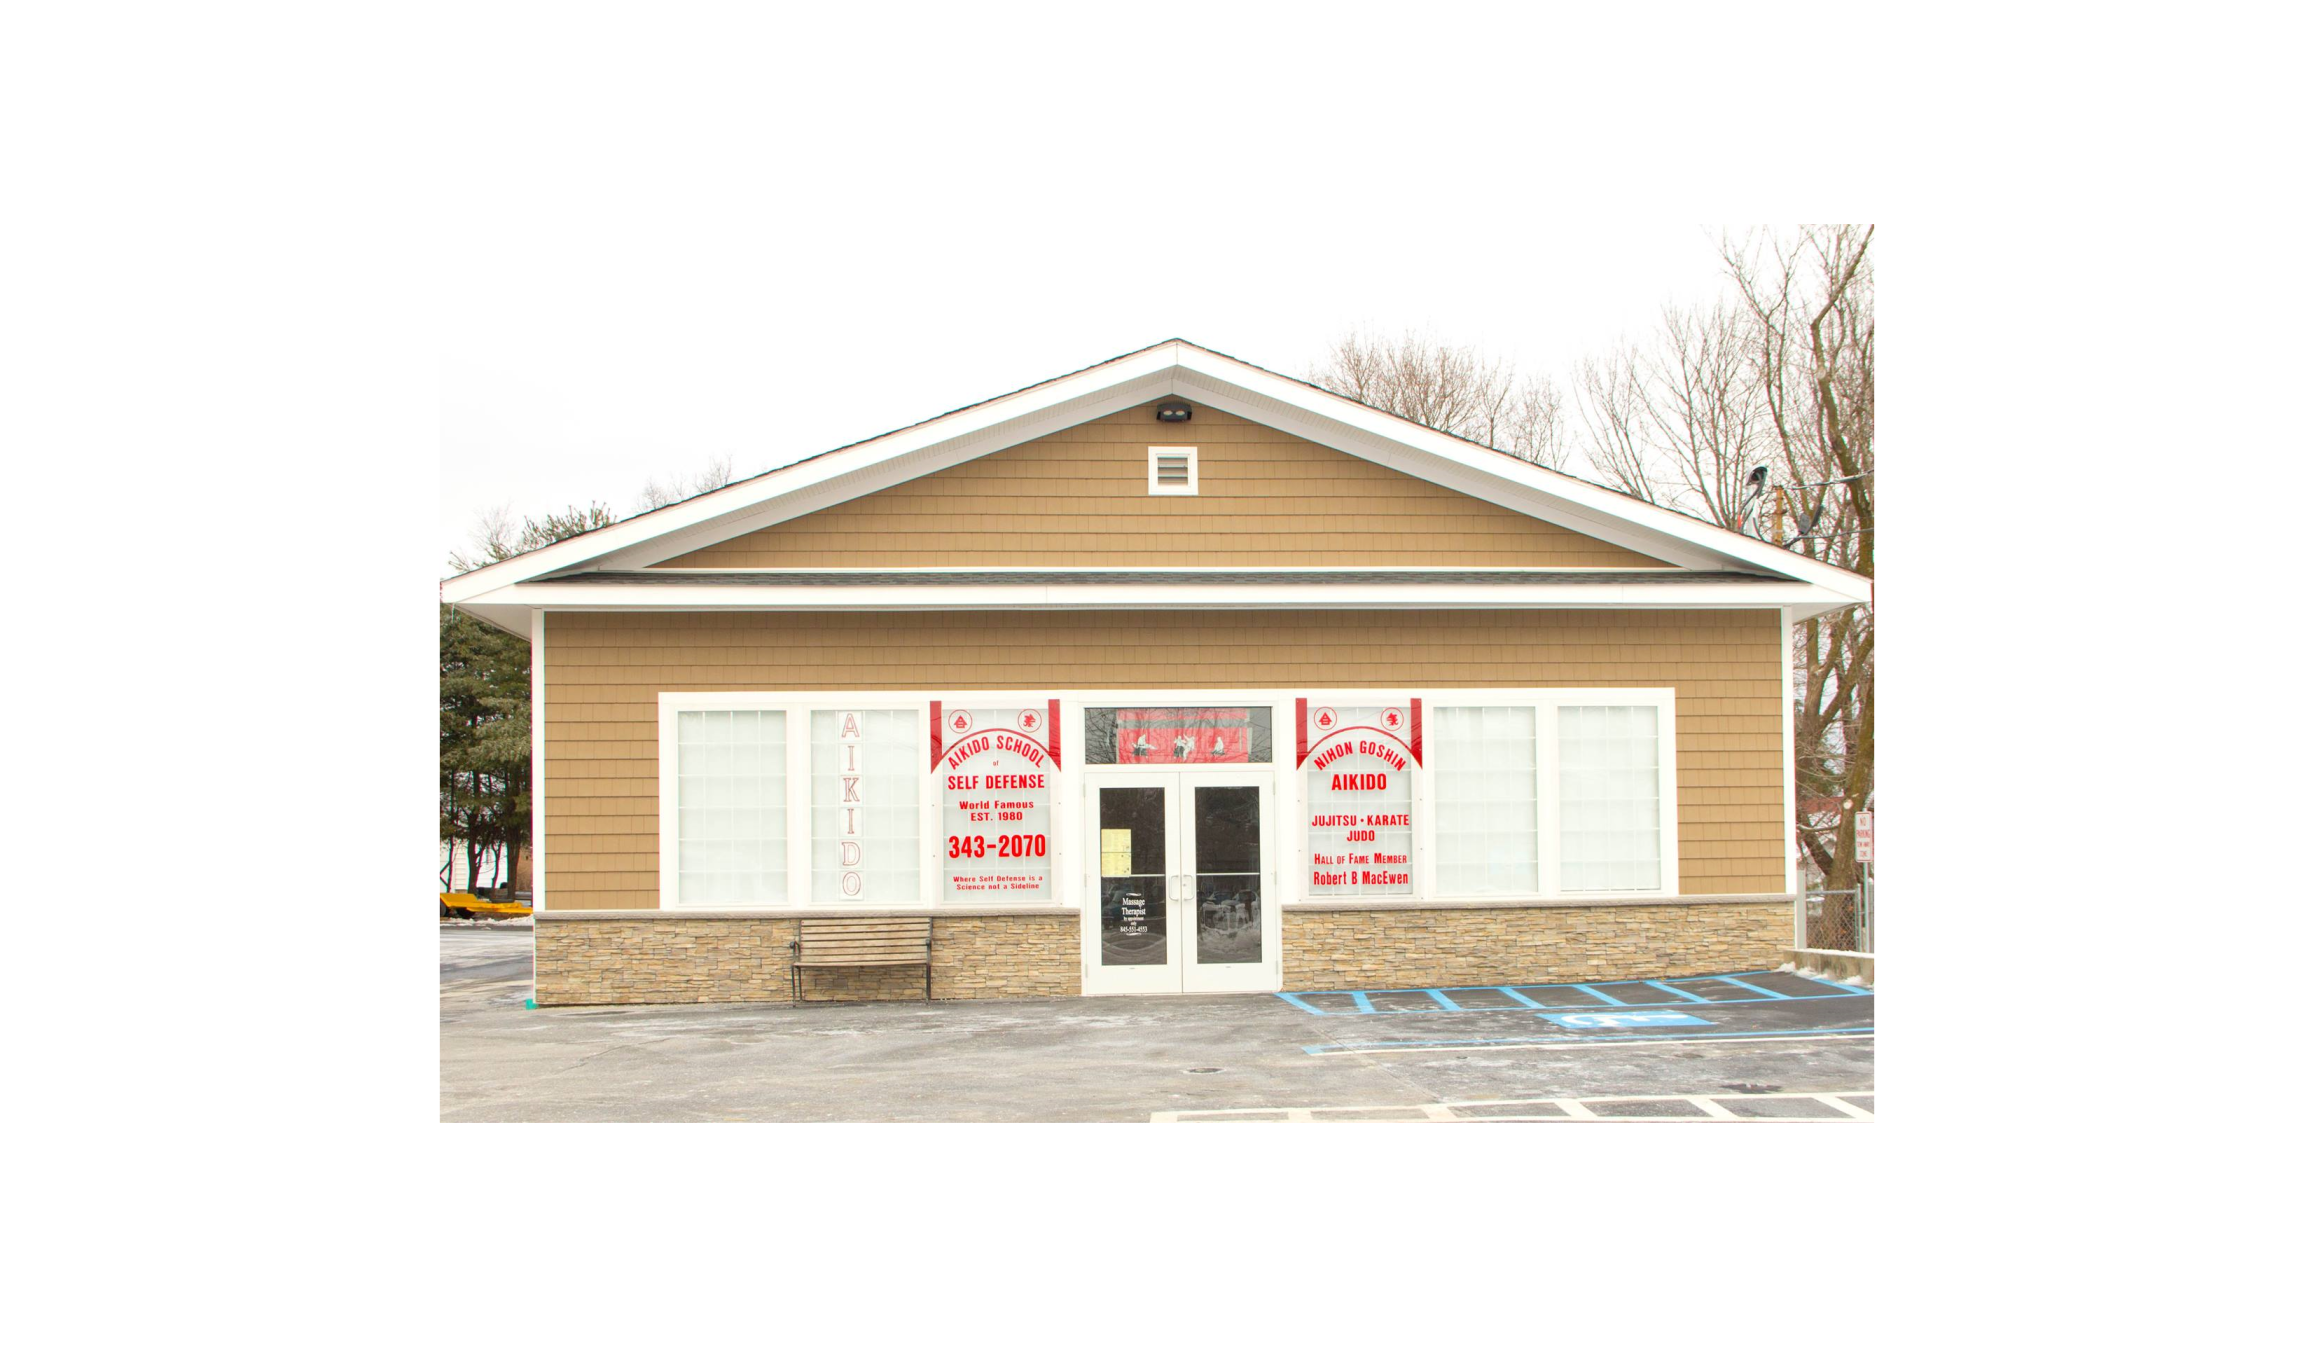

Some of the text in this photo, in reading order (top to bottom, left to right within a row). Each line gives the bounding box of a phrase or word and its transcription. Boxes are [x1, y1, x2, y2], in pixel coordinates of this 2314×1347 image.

[948, 735, 1046, 771] AIKIDO SCHOOL
[1313, 740, 1407, 771] NIHON GOSHIN
[992, 759, 999, 767] of
[947, 774, 1045, 790] SELF DEFENSE
[1331, 773, 1387, 791] AIKIDO
[959, 800, 1034, 810] World Famous
[970, 811, 1023, 821] EST. 1980
[1312, 814, 1410, 827] JUJITSU KARATE
[1346, 830, 1375, 842] JUDO
[948, 834, 1046, 858] 343-2070
[1314, 853, 1407, 865] HALL OF FAME MEMBER
[1313, 871, 1409, 885] Robert B MacEwen
[1122, 897, 1146, 908] Massage
[1121, 907, 1146, 917] Therapist
